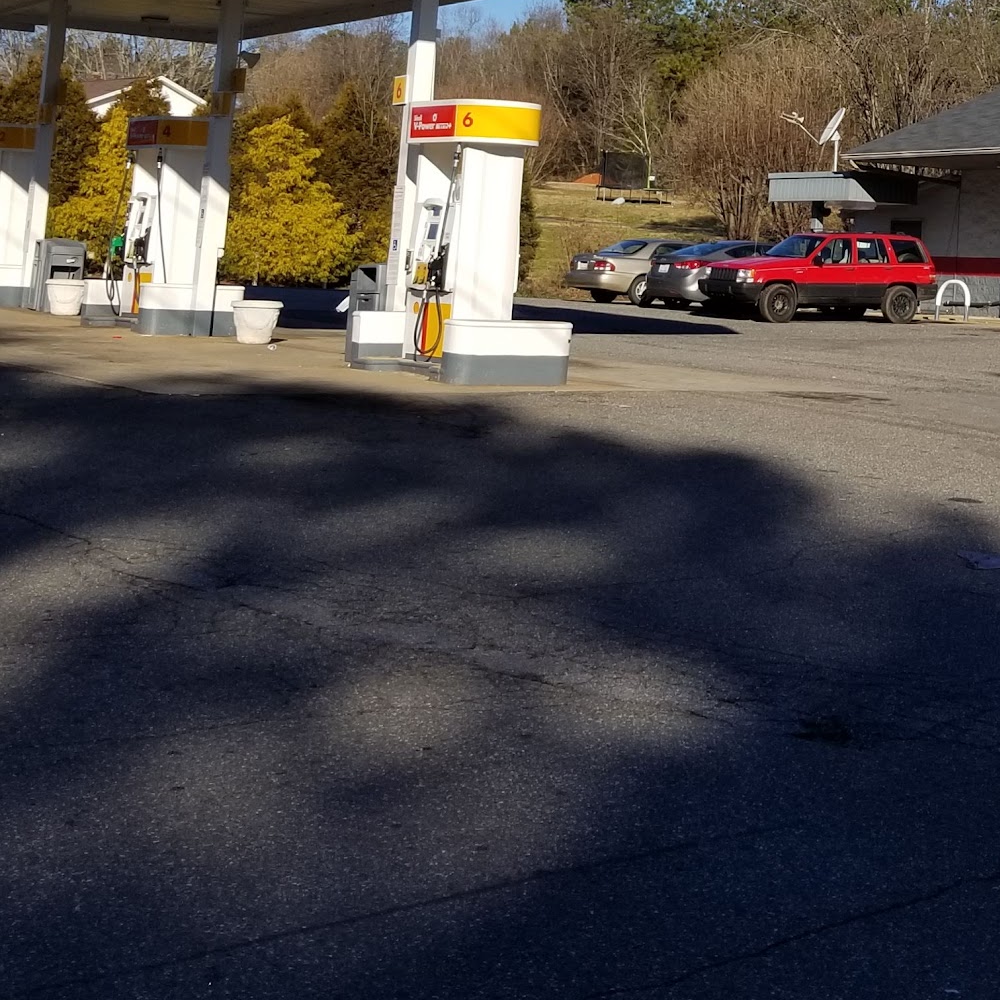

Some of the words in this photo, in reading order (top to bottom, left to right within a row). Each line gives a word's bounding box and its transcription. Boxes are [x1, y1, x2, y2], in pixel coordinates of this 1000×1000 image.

[396, 82, 402, 99] 6
[462, 112, 474, 128] 6
[162, 125, 171, 137] 4
